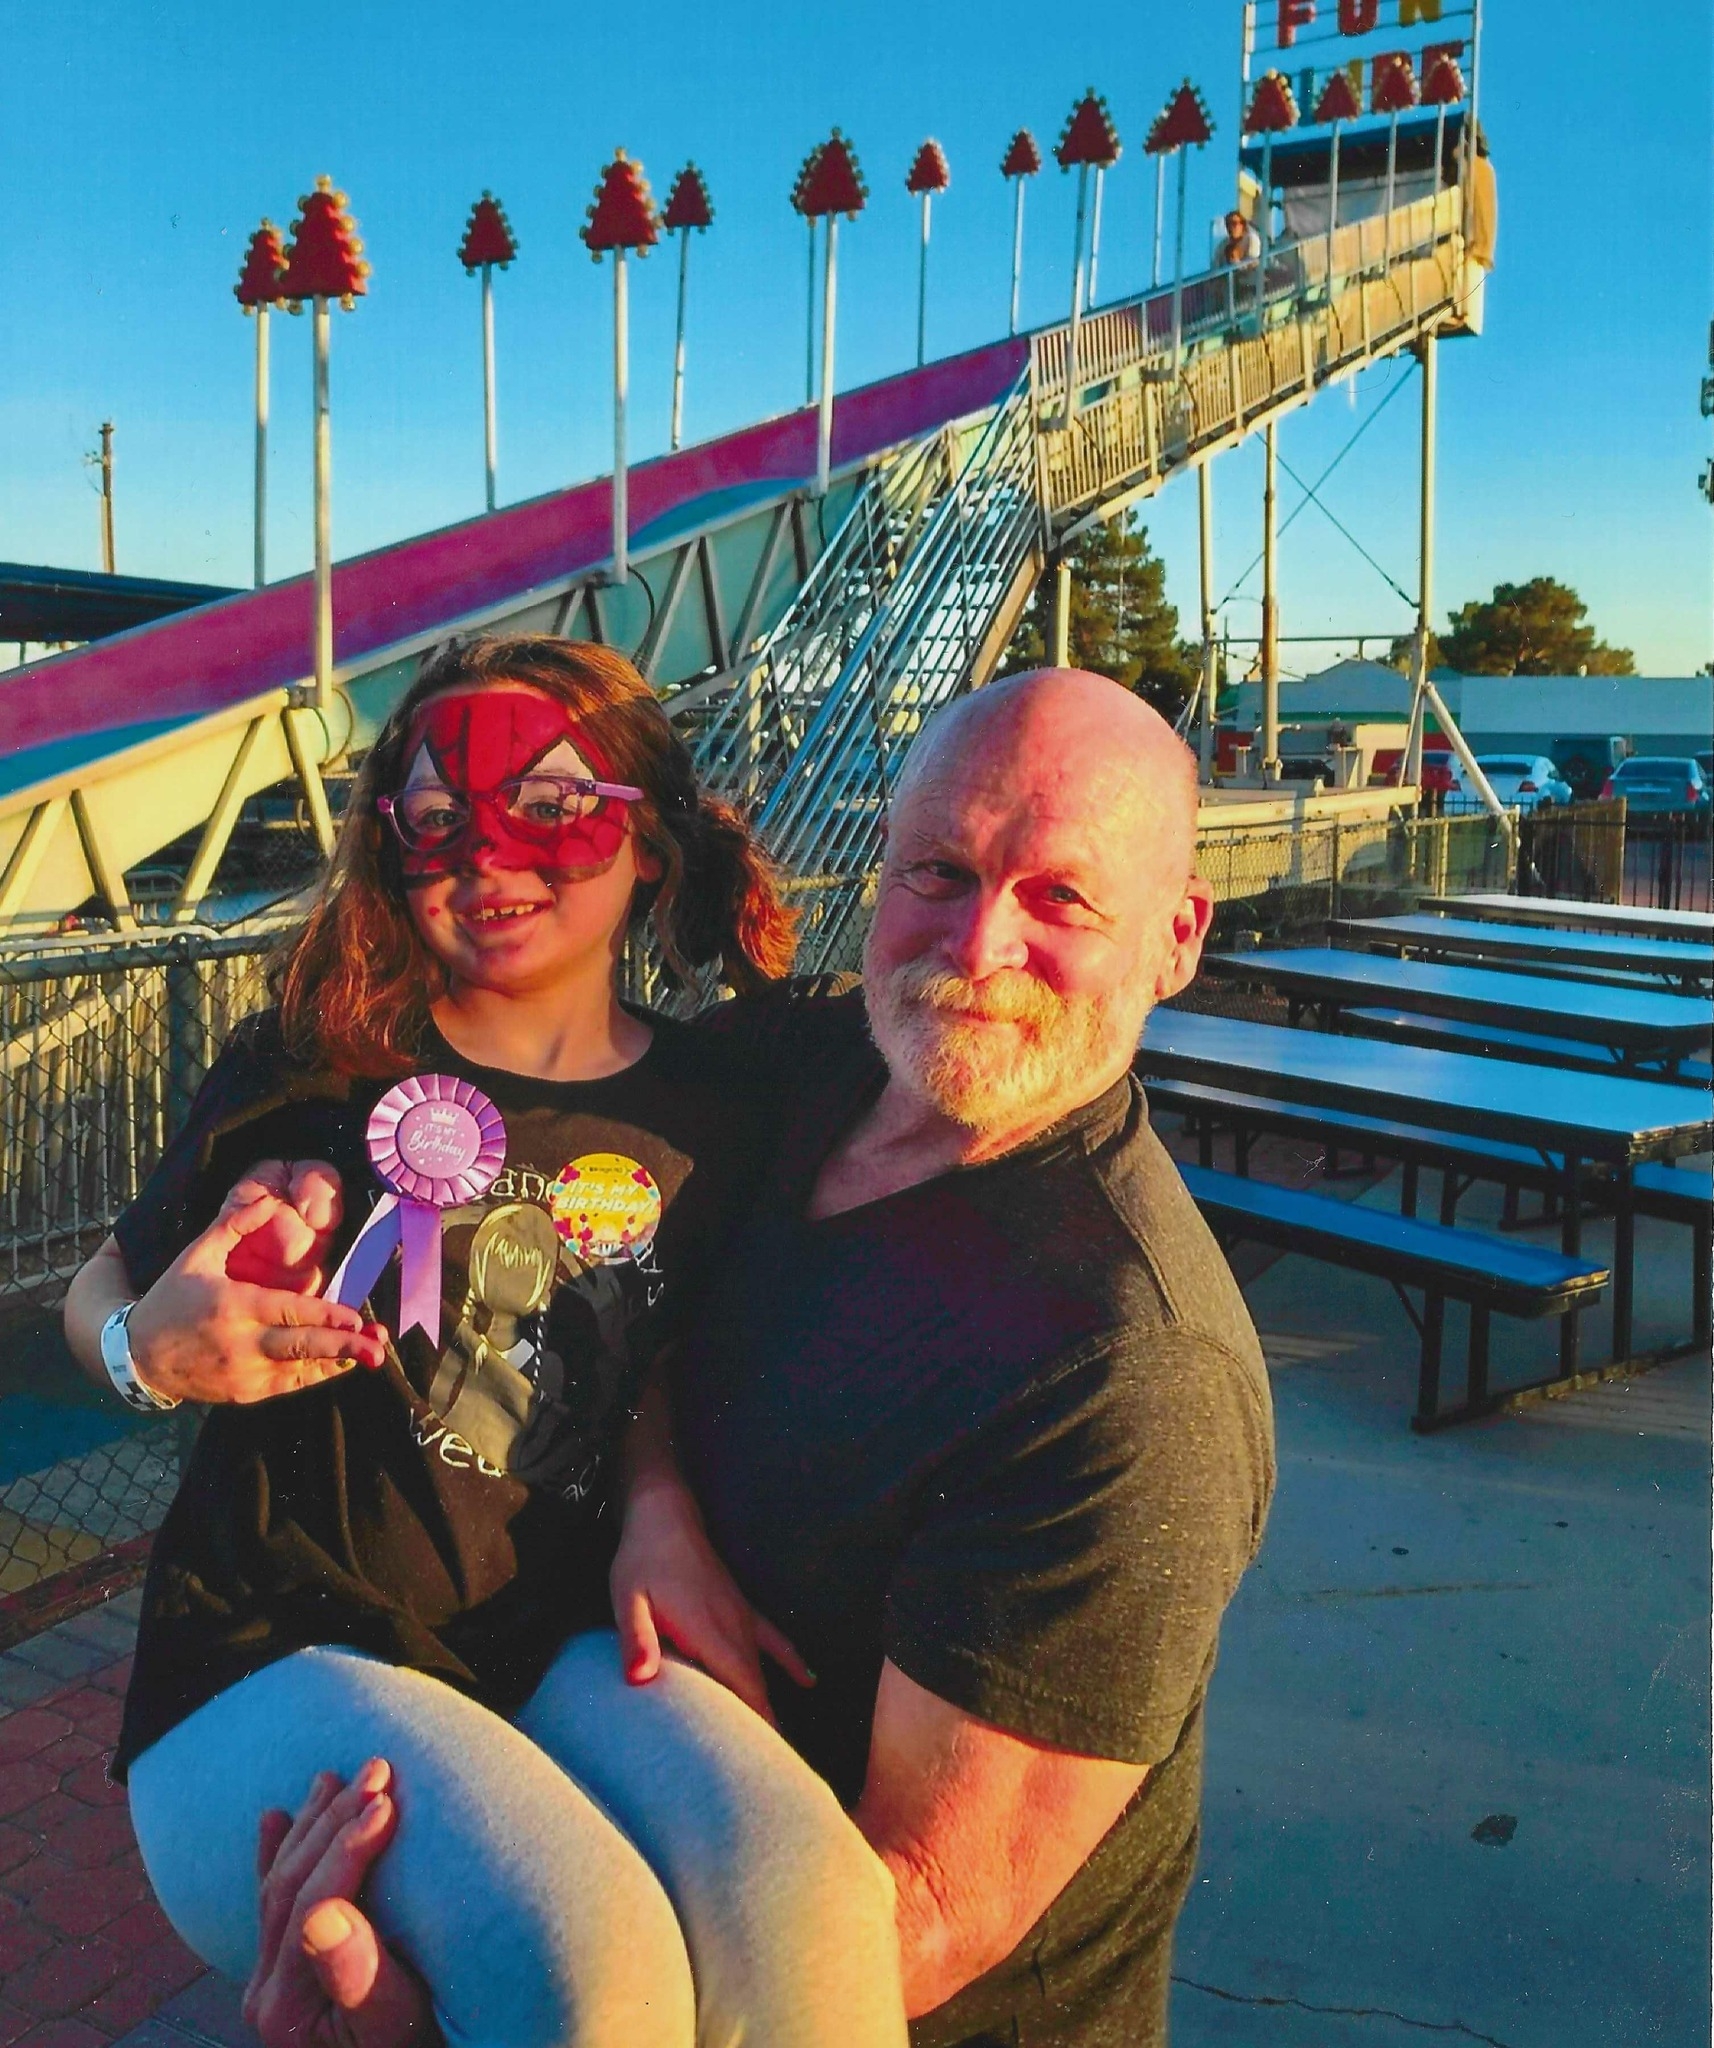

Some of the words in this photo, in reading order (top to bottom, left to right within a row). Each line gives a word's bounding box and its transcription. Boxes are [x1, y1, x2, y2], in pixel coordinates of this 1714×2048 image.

[407, 1129, 466, 1165] Birthday
[569, 1181, 605, 1196] IT'S
[610, 1184, 640, 1197] MY
